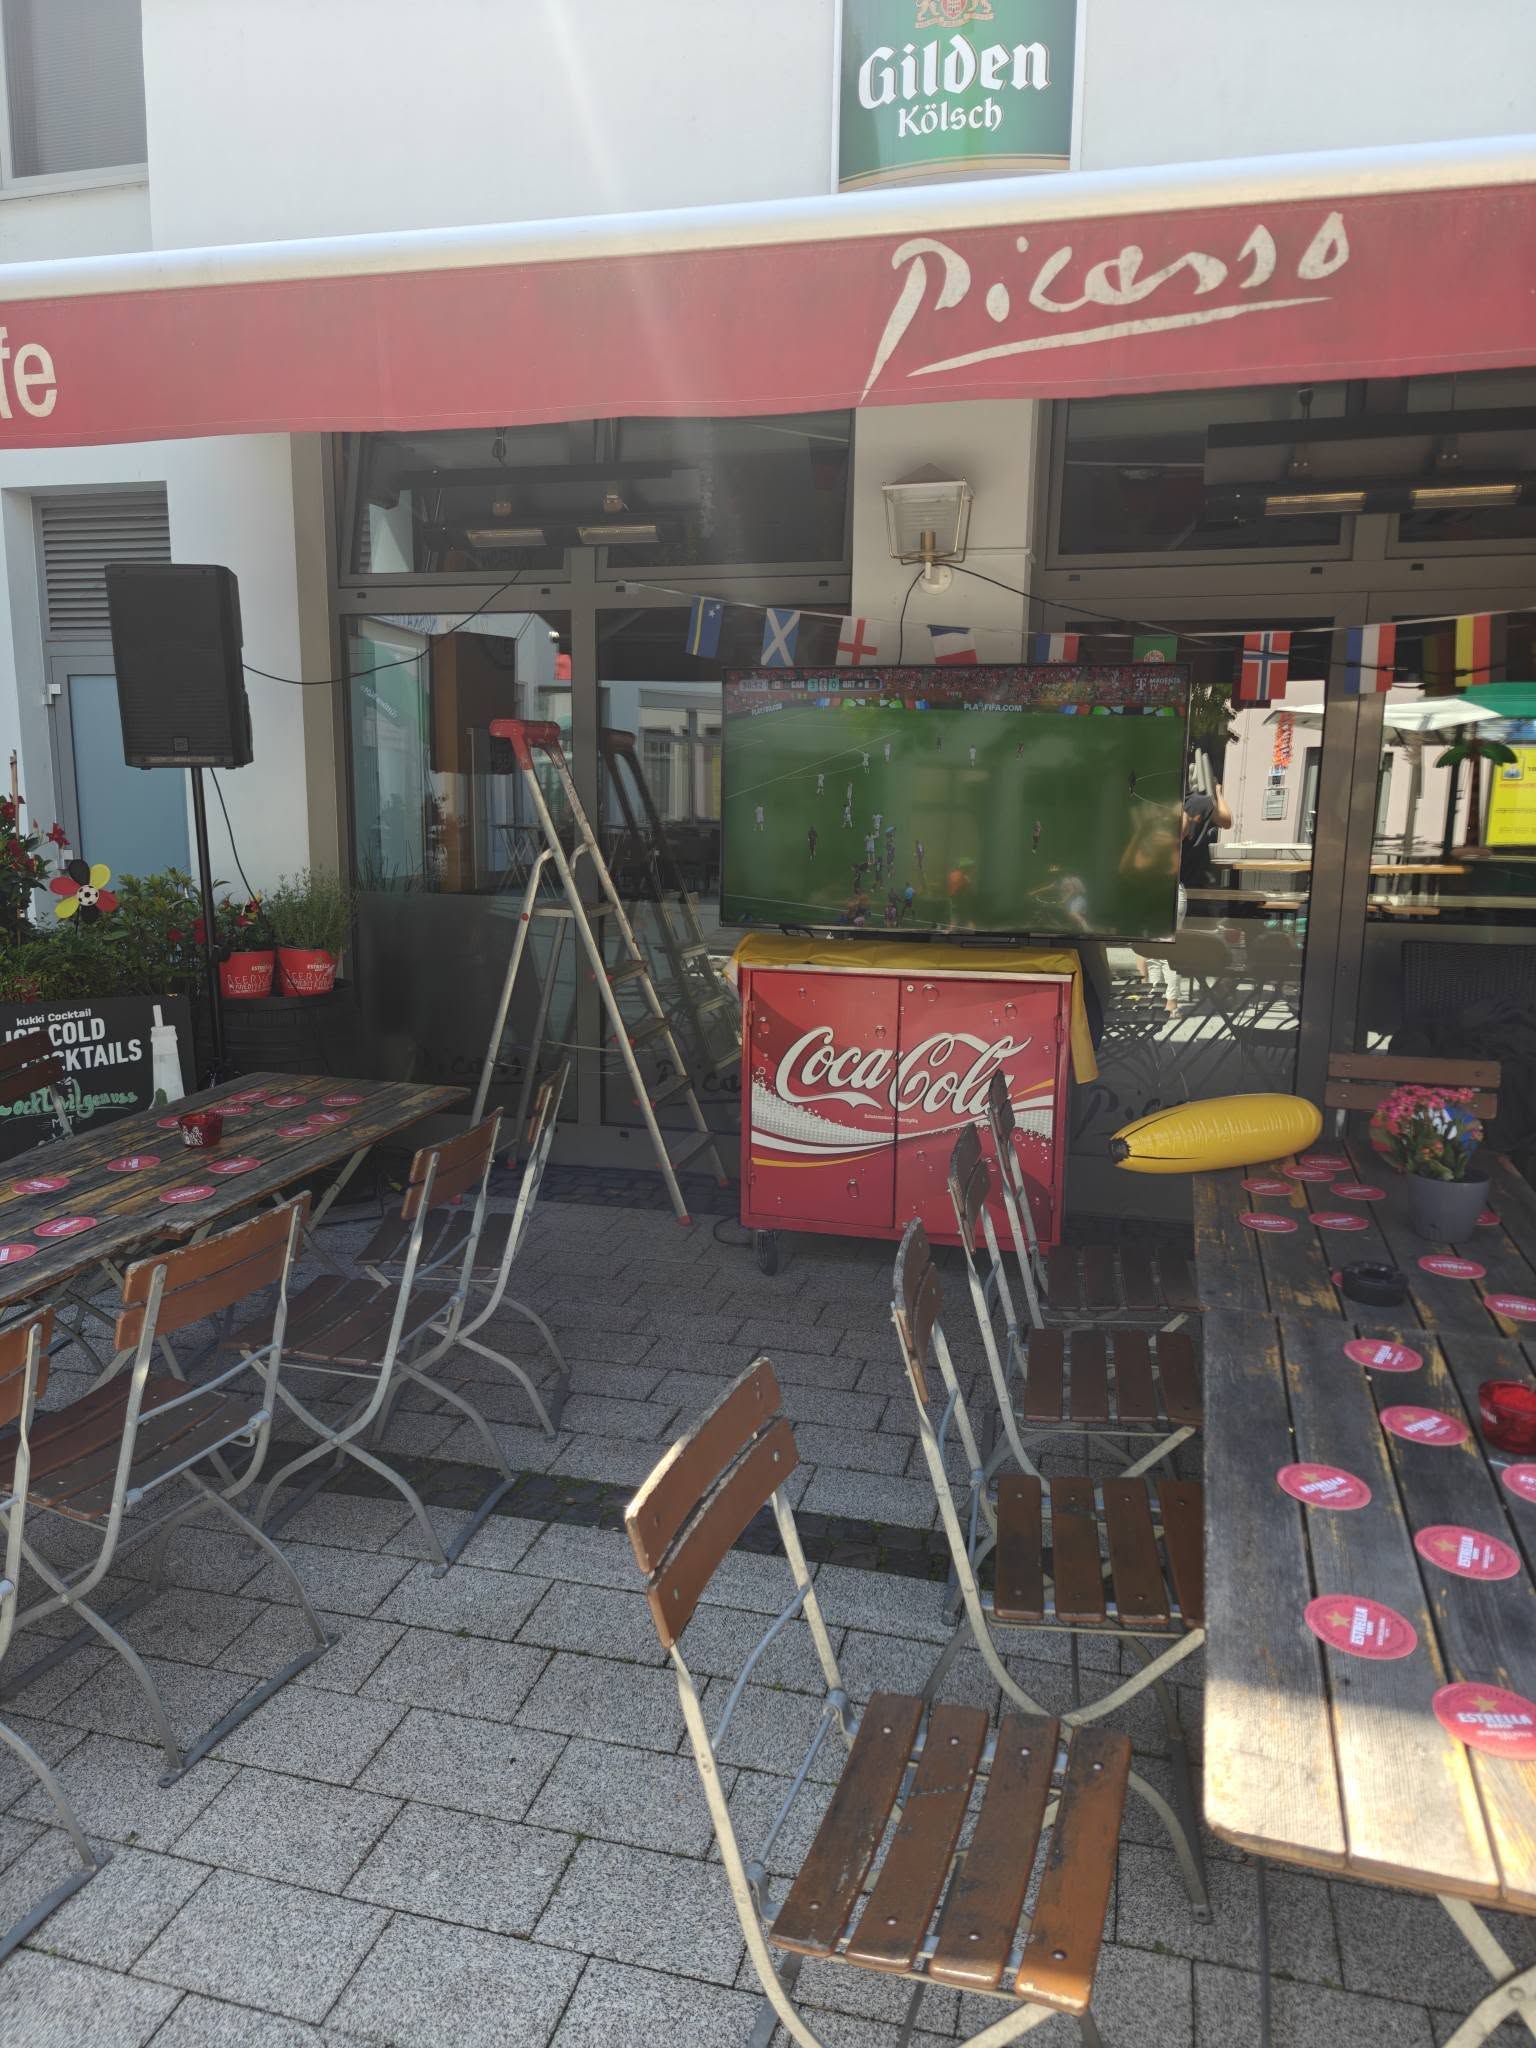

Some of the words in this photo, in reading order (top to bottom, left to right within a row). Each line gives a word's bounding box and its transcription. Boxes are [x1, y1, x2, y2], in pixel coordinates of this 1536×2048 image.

[858, 33, 1052, 110] Gilden
[897, 96, 1004, 138] Kölsch
[859, 211, 1350, 405] Picasso
[16, 1014, 45, 1027] kukki
[48, 1007, 92, 1022] Cocktail
[48, 1017, 106, 1047] COLD
